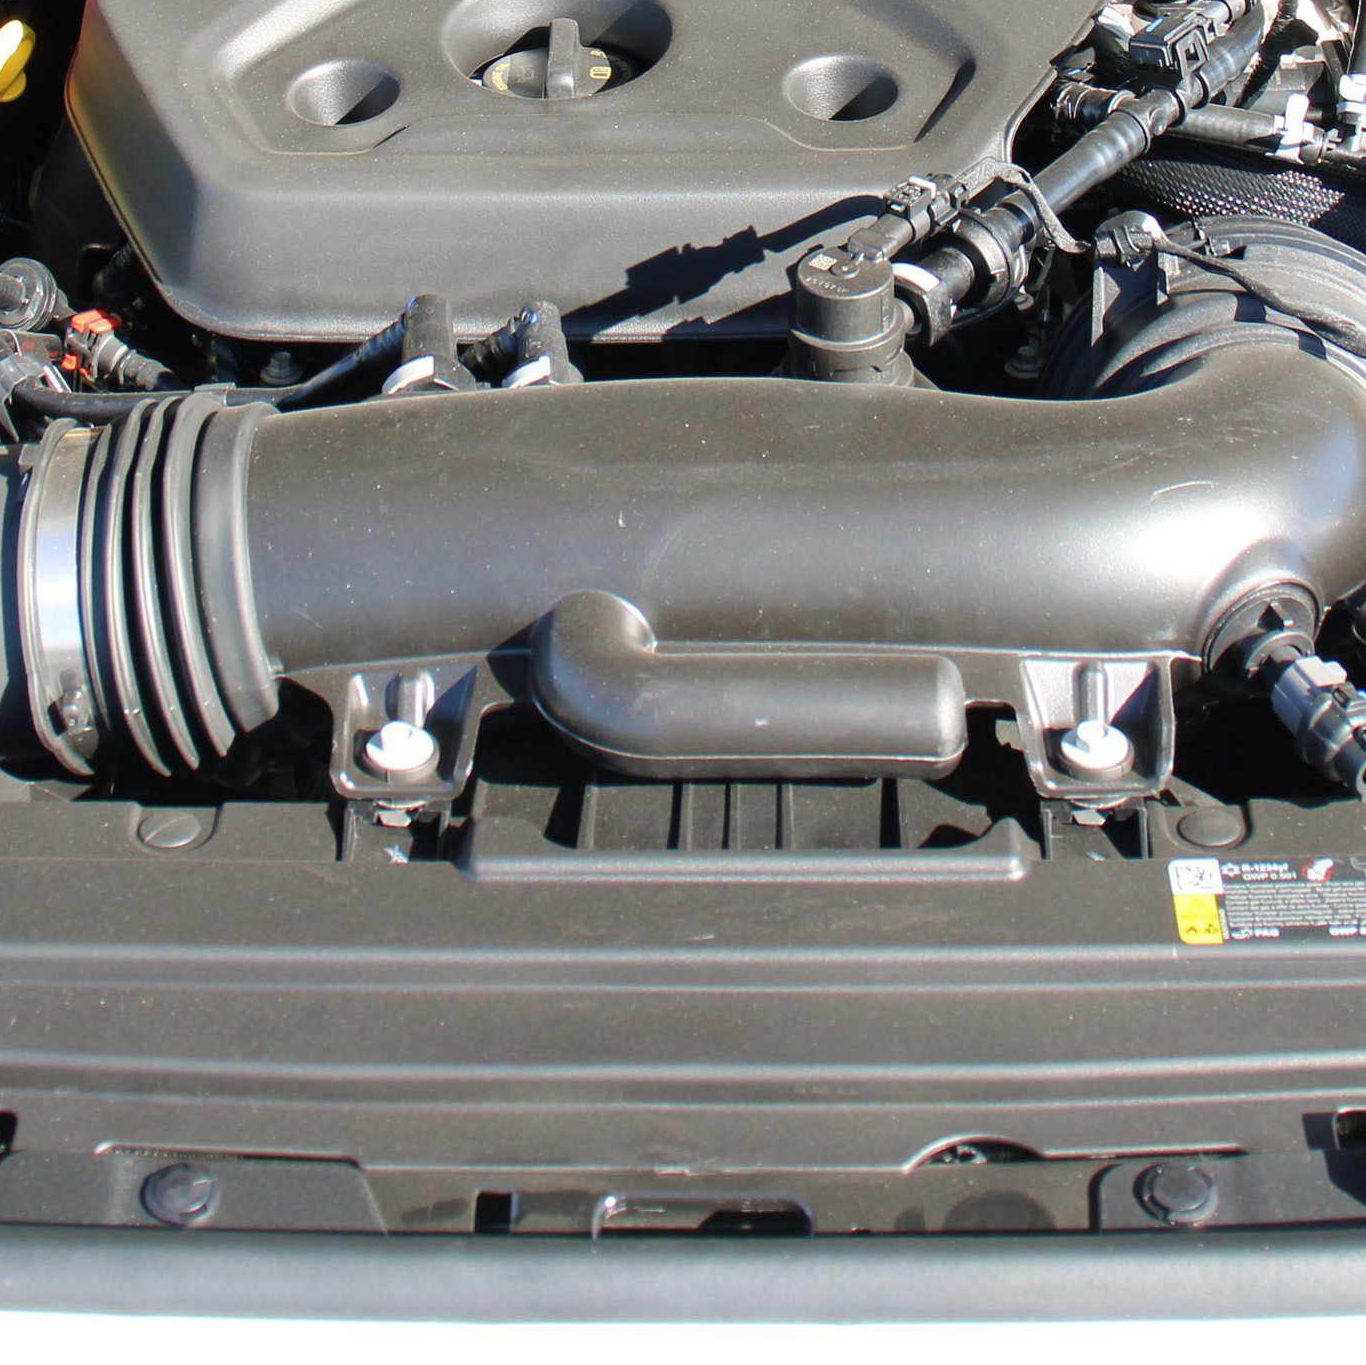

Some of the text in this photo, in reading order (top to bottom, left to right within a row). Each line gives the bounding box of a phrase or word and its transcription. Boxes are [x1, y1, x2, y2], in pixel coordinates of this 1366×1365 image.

[1241, 863, 1289, 873] R-1234yf
[1242, 871, 1297, 881] GWP 0.501
[1253, 927, 1281, 938] PAG
[1328, 926, 1358, 937] GWP
